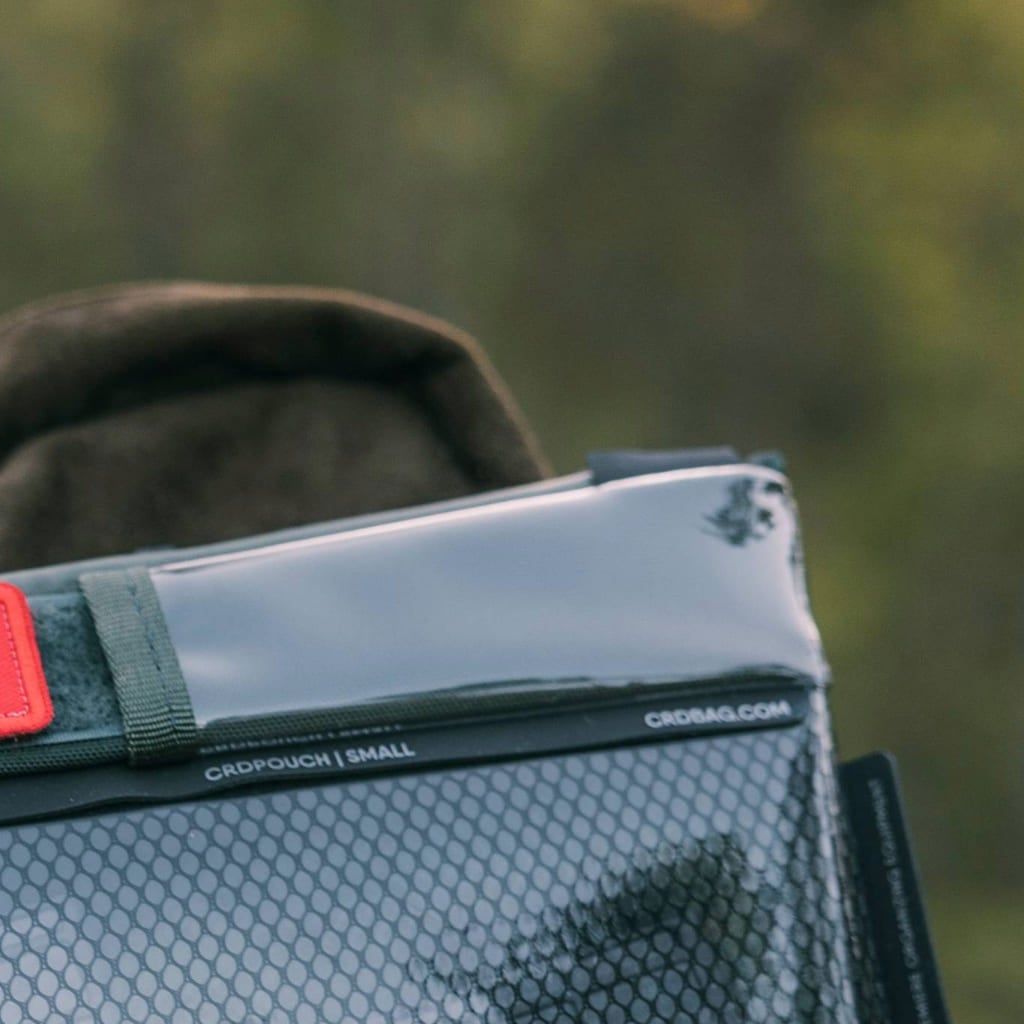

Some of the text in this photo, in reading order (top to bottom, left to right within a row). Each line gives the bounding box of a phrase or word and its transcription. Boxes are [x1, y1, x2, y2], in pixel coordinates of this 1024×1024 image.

[643, 700, 792, 729] CRDBAG.COM
[204, 753, 330, 782] CRDPOUCH
[345, 742, 416, 764] SMALL
